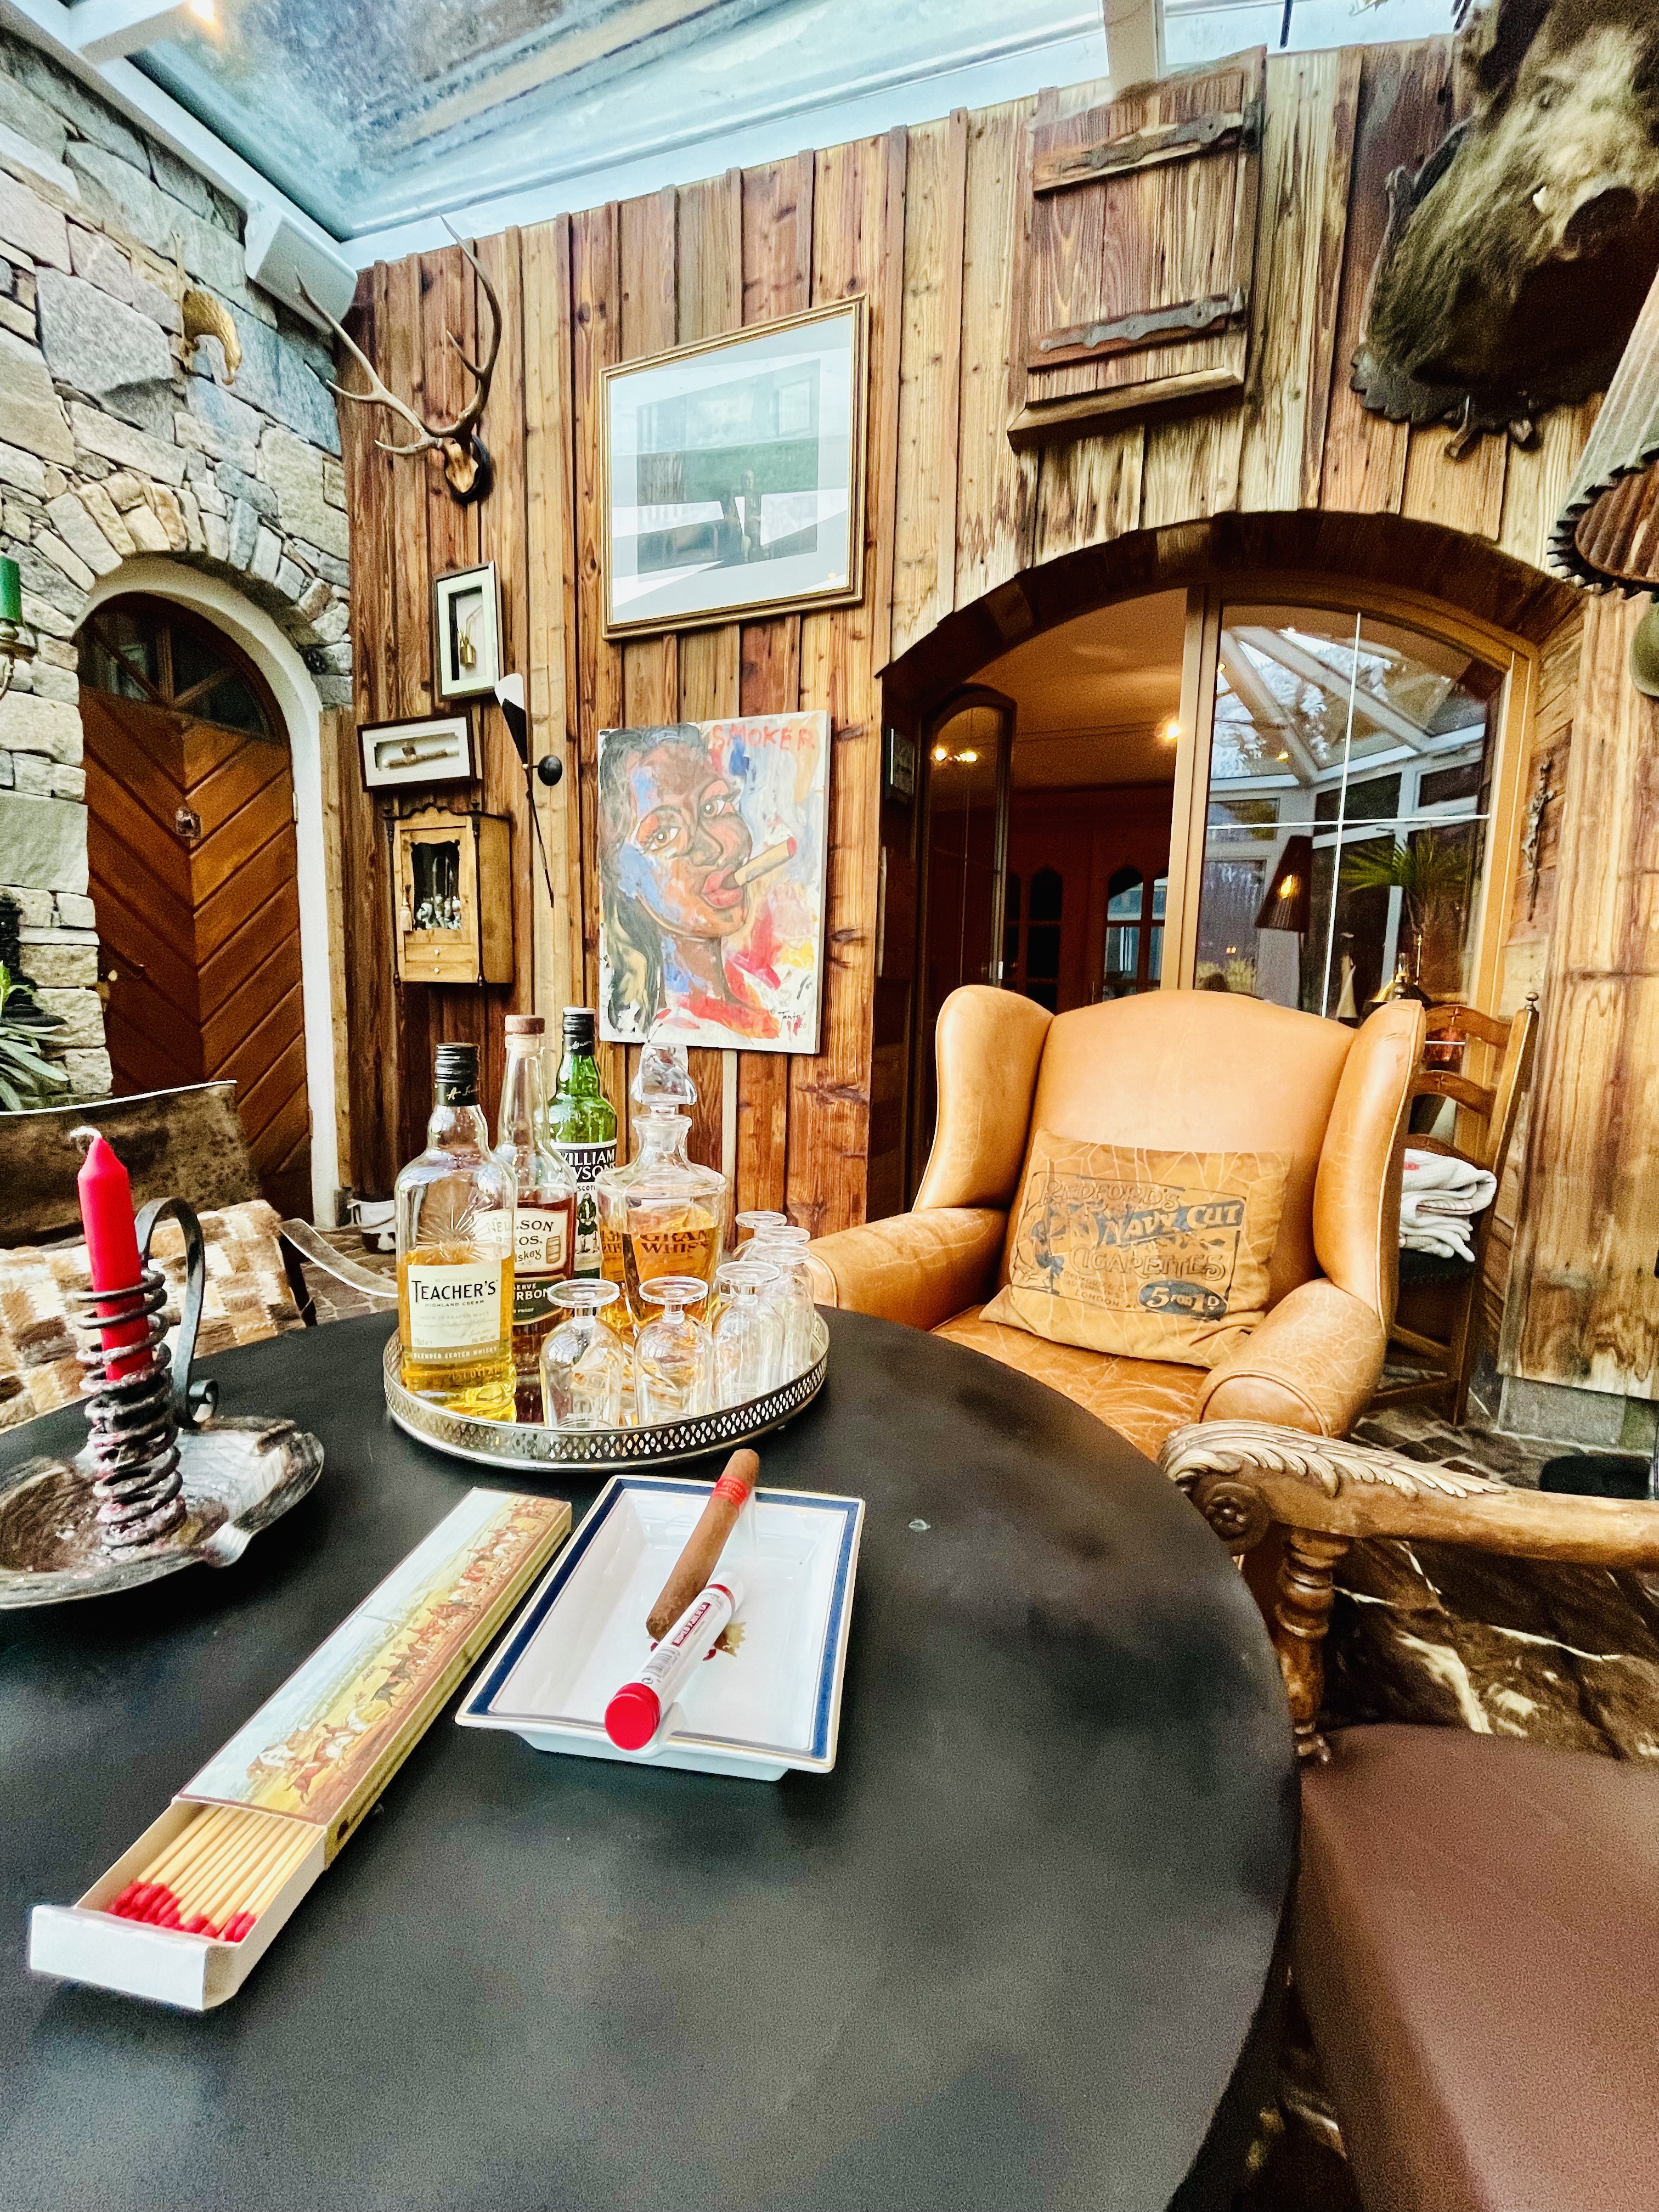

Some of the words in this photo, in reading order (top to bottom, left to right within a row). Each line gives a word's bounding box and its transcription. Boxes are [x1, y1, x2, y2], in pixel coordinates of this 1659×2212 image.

[710, 722, 816, 752] SMOKER
[1099, 1211, 1178, 1245] NAVY
[1071, 1247, 1227, 1281] CIGARETTES
[411, 1280, 496, 1303] TEACHER'S
[514, 1287, 551, 1301] RBON
[1075, 1289, 1119, 1307] LONDON
[1146, 1286, 1169, 1307] 5
